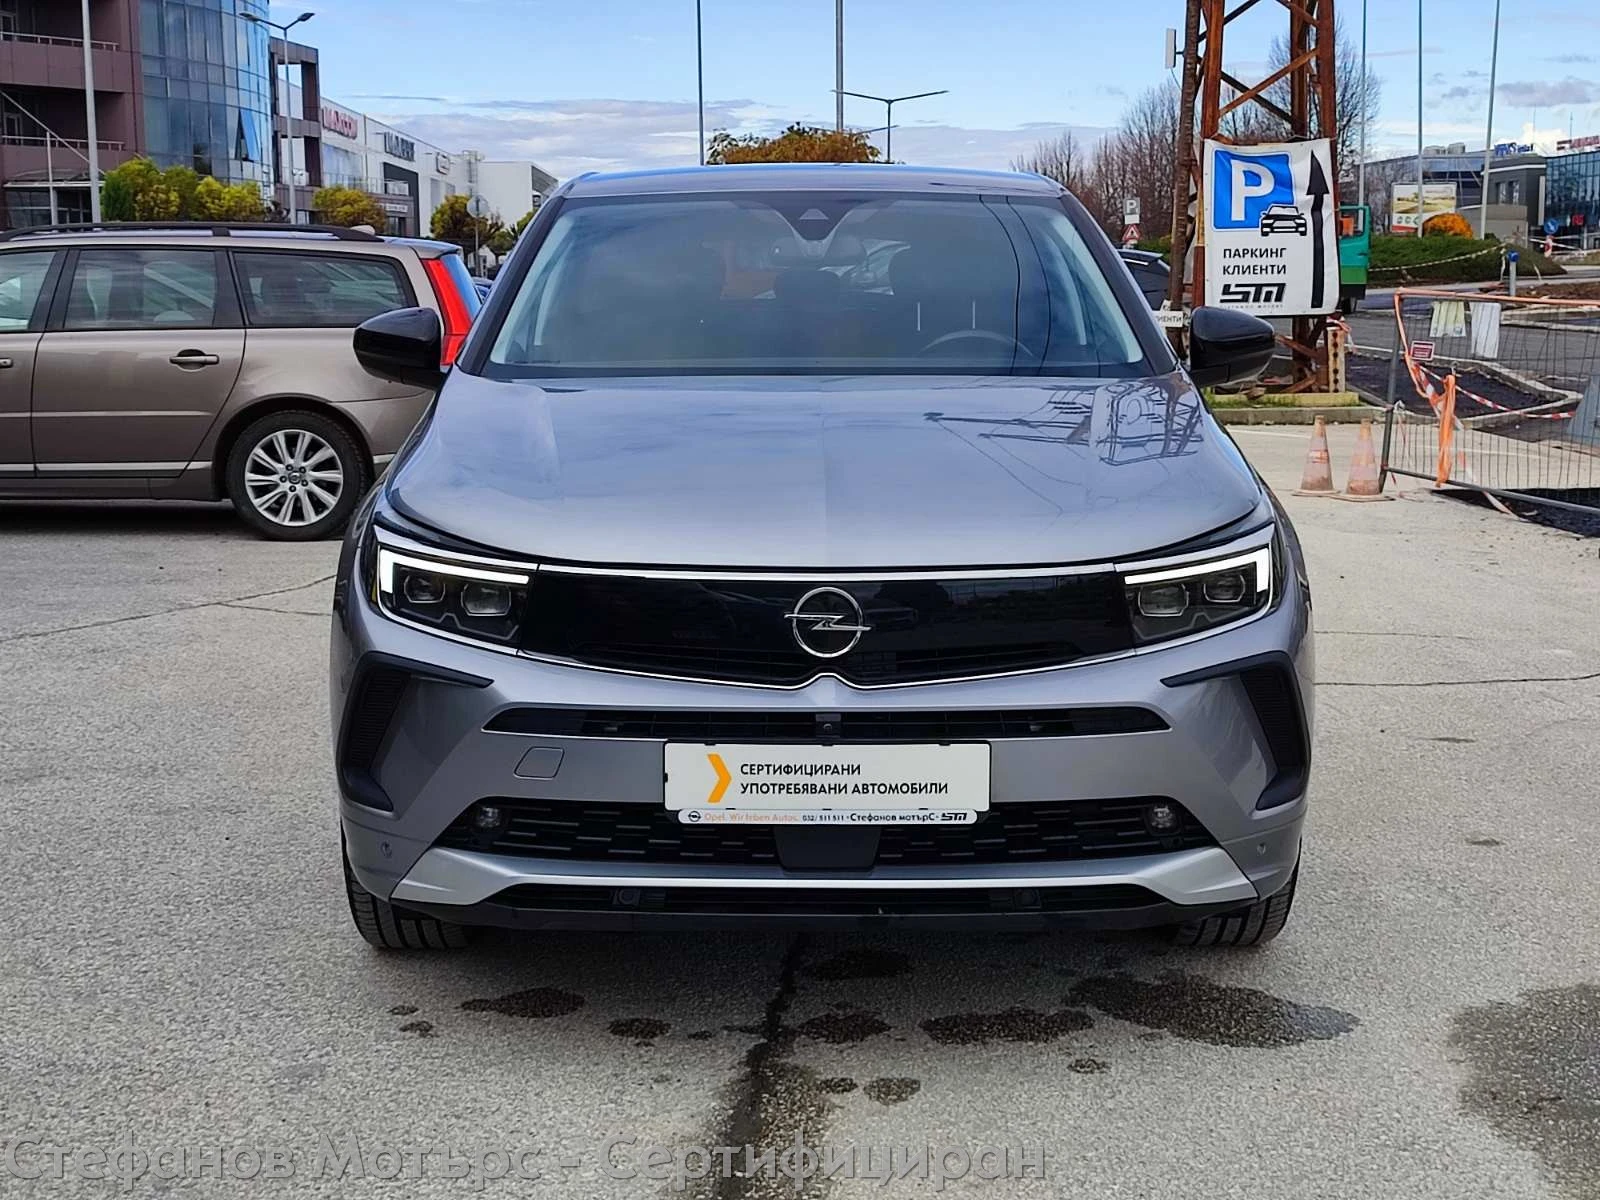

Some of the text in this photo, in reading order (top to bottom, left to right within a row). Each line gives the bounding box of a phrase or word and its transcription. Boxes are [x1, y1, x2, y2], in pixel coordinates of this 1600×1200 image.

[1223, 248, 1286, 259] ПАРКИНГ
[1223, 264, 1286, 275] КЛИЕНТИ
[741, 763, 861, 777] СЕРТИФИЦИРАНИ
[741, 782, 949, 794] УПОТРЕБЯВАНИ АВТОМОБИЛИ
